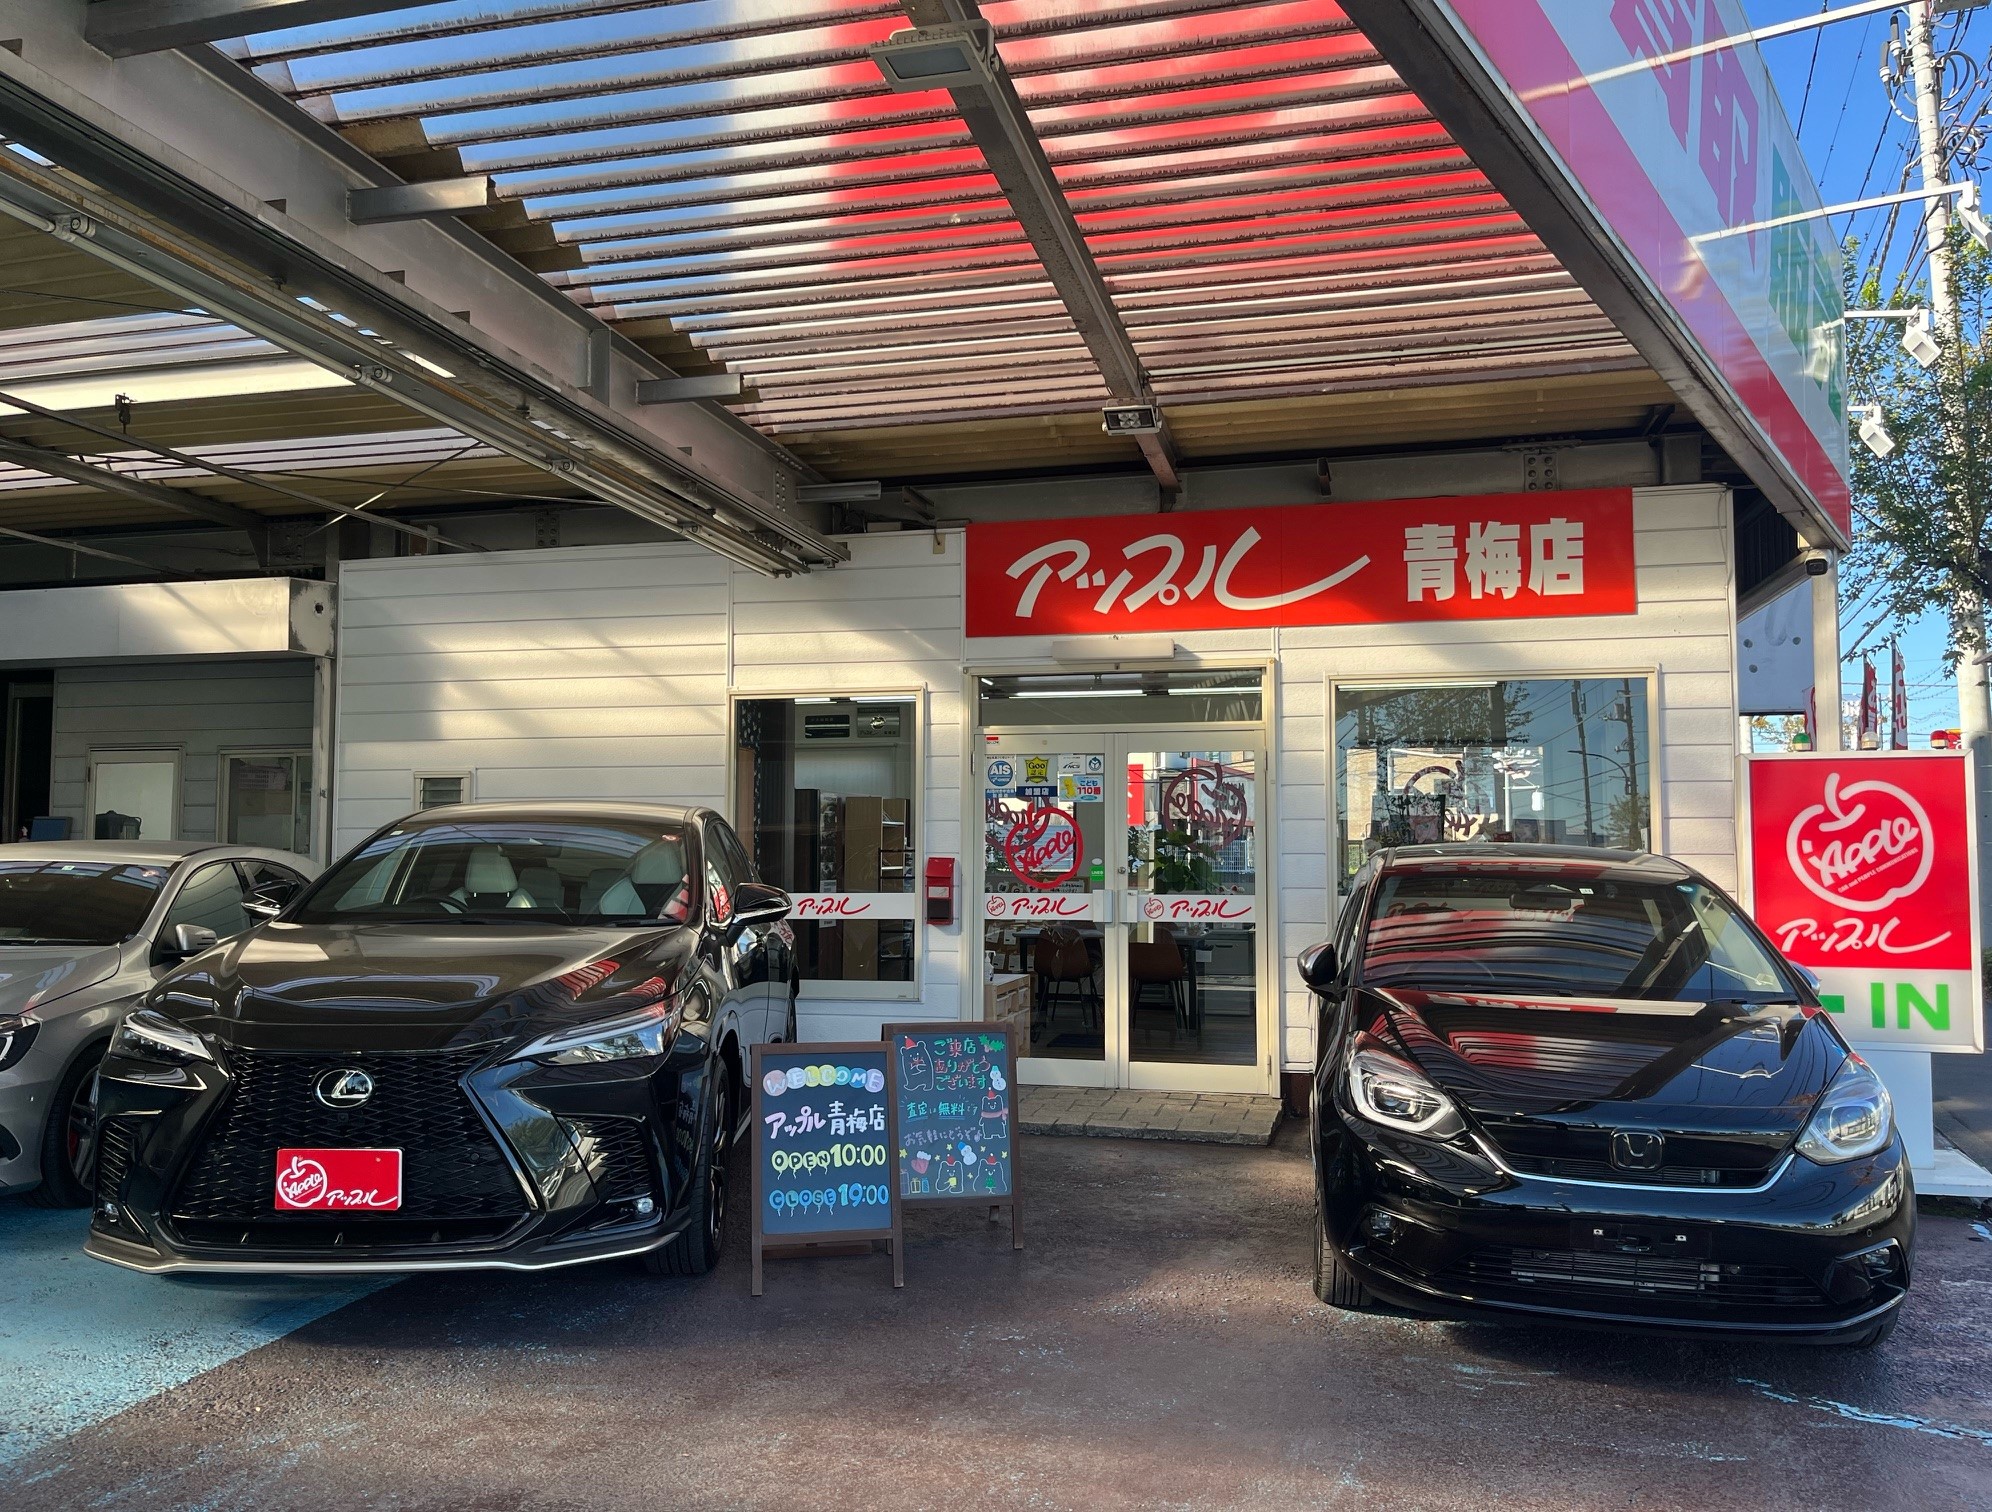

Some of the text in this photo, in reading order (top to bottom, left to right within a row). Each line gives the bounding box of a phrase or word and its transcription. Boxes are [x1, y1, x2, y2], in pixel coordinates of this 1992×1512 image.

[1005, 517, 1585, 618] アップル 青梅店
[1016, 829, 1076, 876] Apple
[1803, 816, 1919, 887] Apple
[797, 897, 871, 915] アップル
[1011, 897, 1089, 915] アップル
[1170, 899, 1252, 918] アップル
[1775, 916, 1953, 954] アップル
[934, 1037, 976, 1058] ご来店
[935, 1055, 991, 1074] ありがとう
[766, 1067, 884, 1096] WELCOME
[936, 1074, 987, 1091] ございます
[765, 1101, 885, 1139] アップル 青梅店
[771, 1143, 886, 1173] OPEN 10:00
[284, 1173, 322, 1198] Apple
[326, 1189, 398, 1206] アップル
[769, 1183, 889, 1210] CLOSE 19:00
